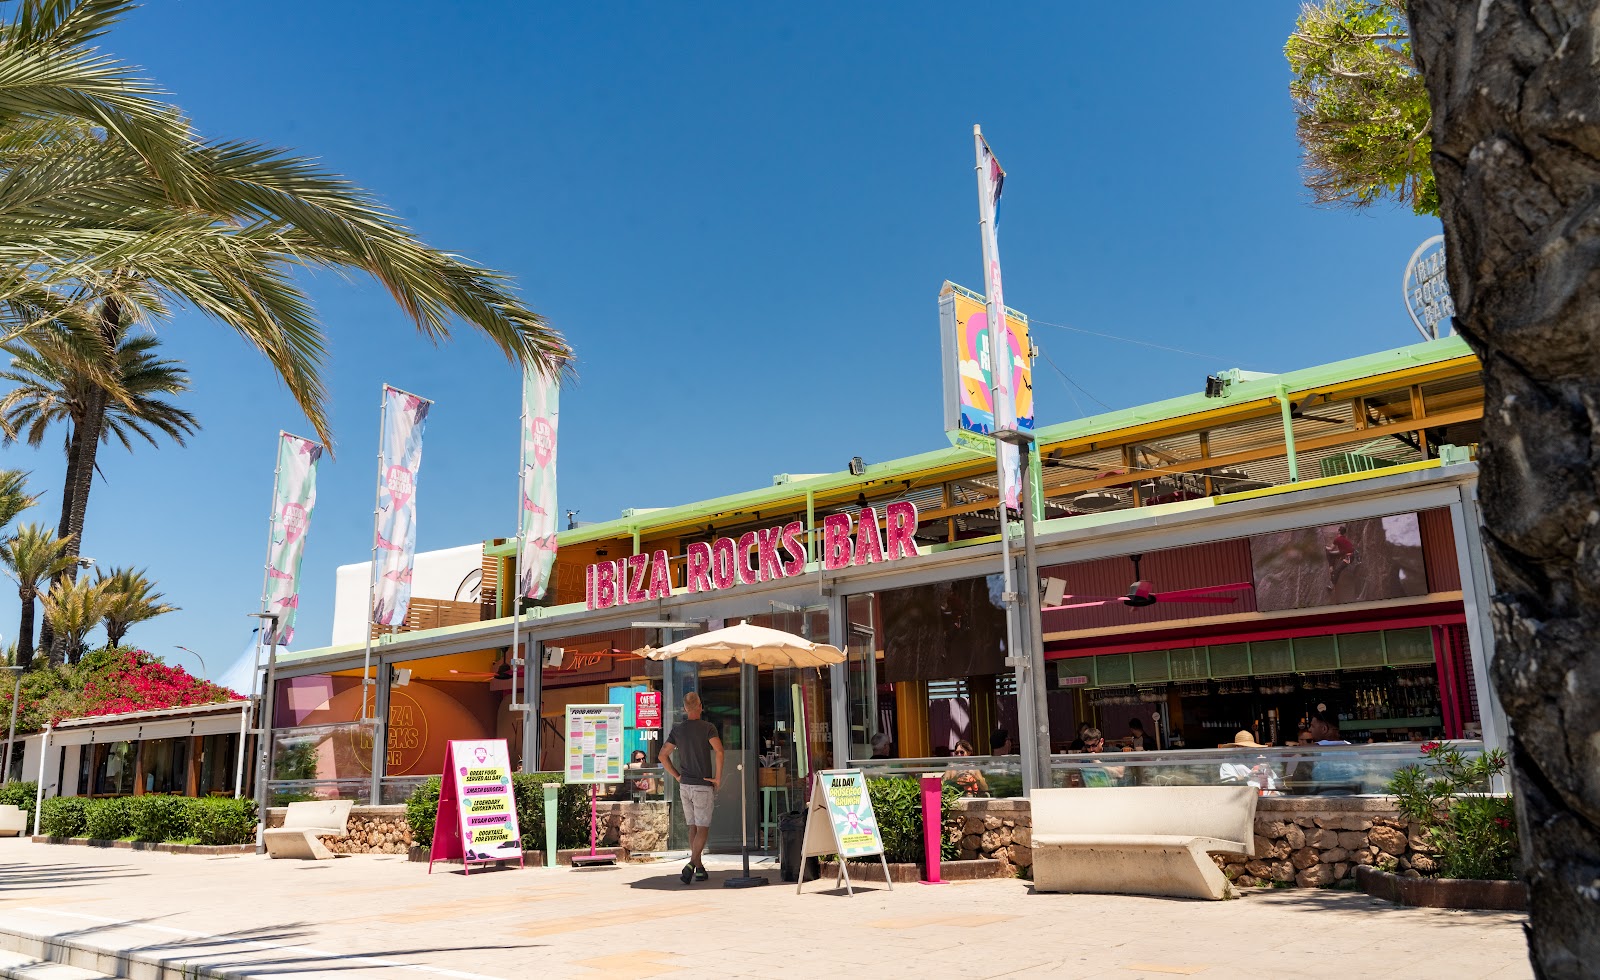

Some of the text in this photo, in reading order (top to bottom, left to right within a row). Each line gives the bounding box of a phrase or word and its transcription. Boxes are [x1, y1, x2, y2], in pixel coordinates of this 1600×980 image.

[586, 550, 673, 611] IBIZA
[687, 520, 809, 594] ROCKS
[823, 501, 919, 570] BAR
[360, 728, 418, 748] RCKS
[831, 778, 855, 787] ALL DAY
[829, 787, 862, 797] PROSECCO
[835, 796, 861, 806] BRUNCH
[484, 834, 509, 842] EVERYONE
